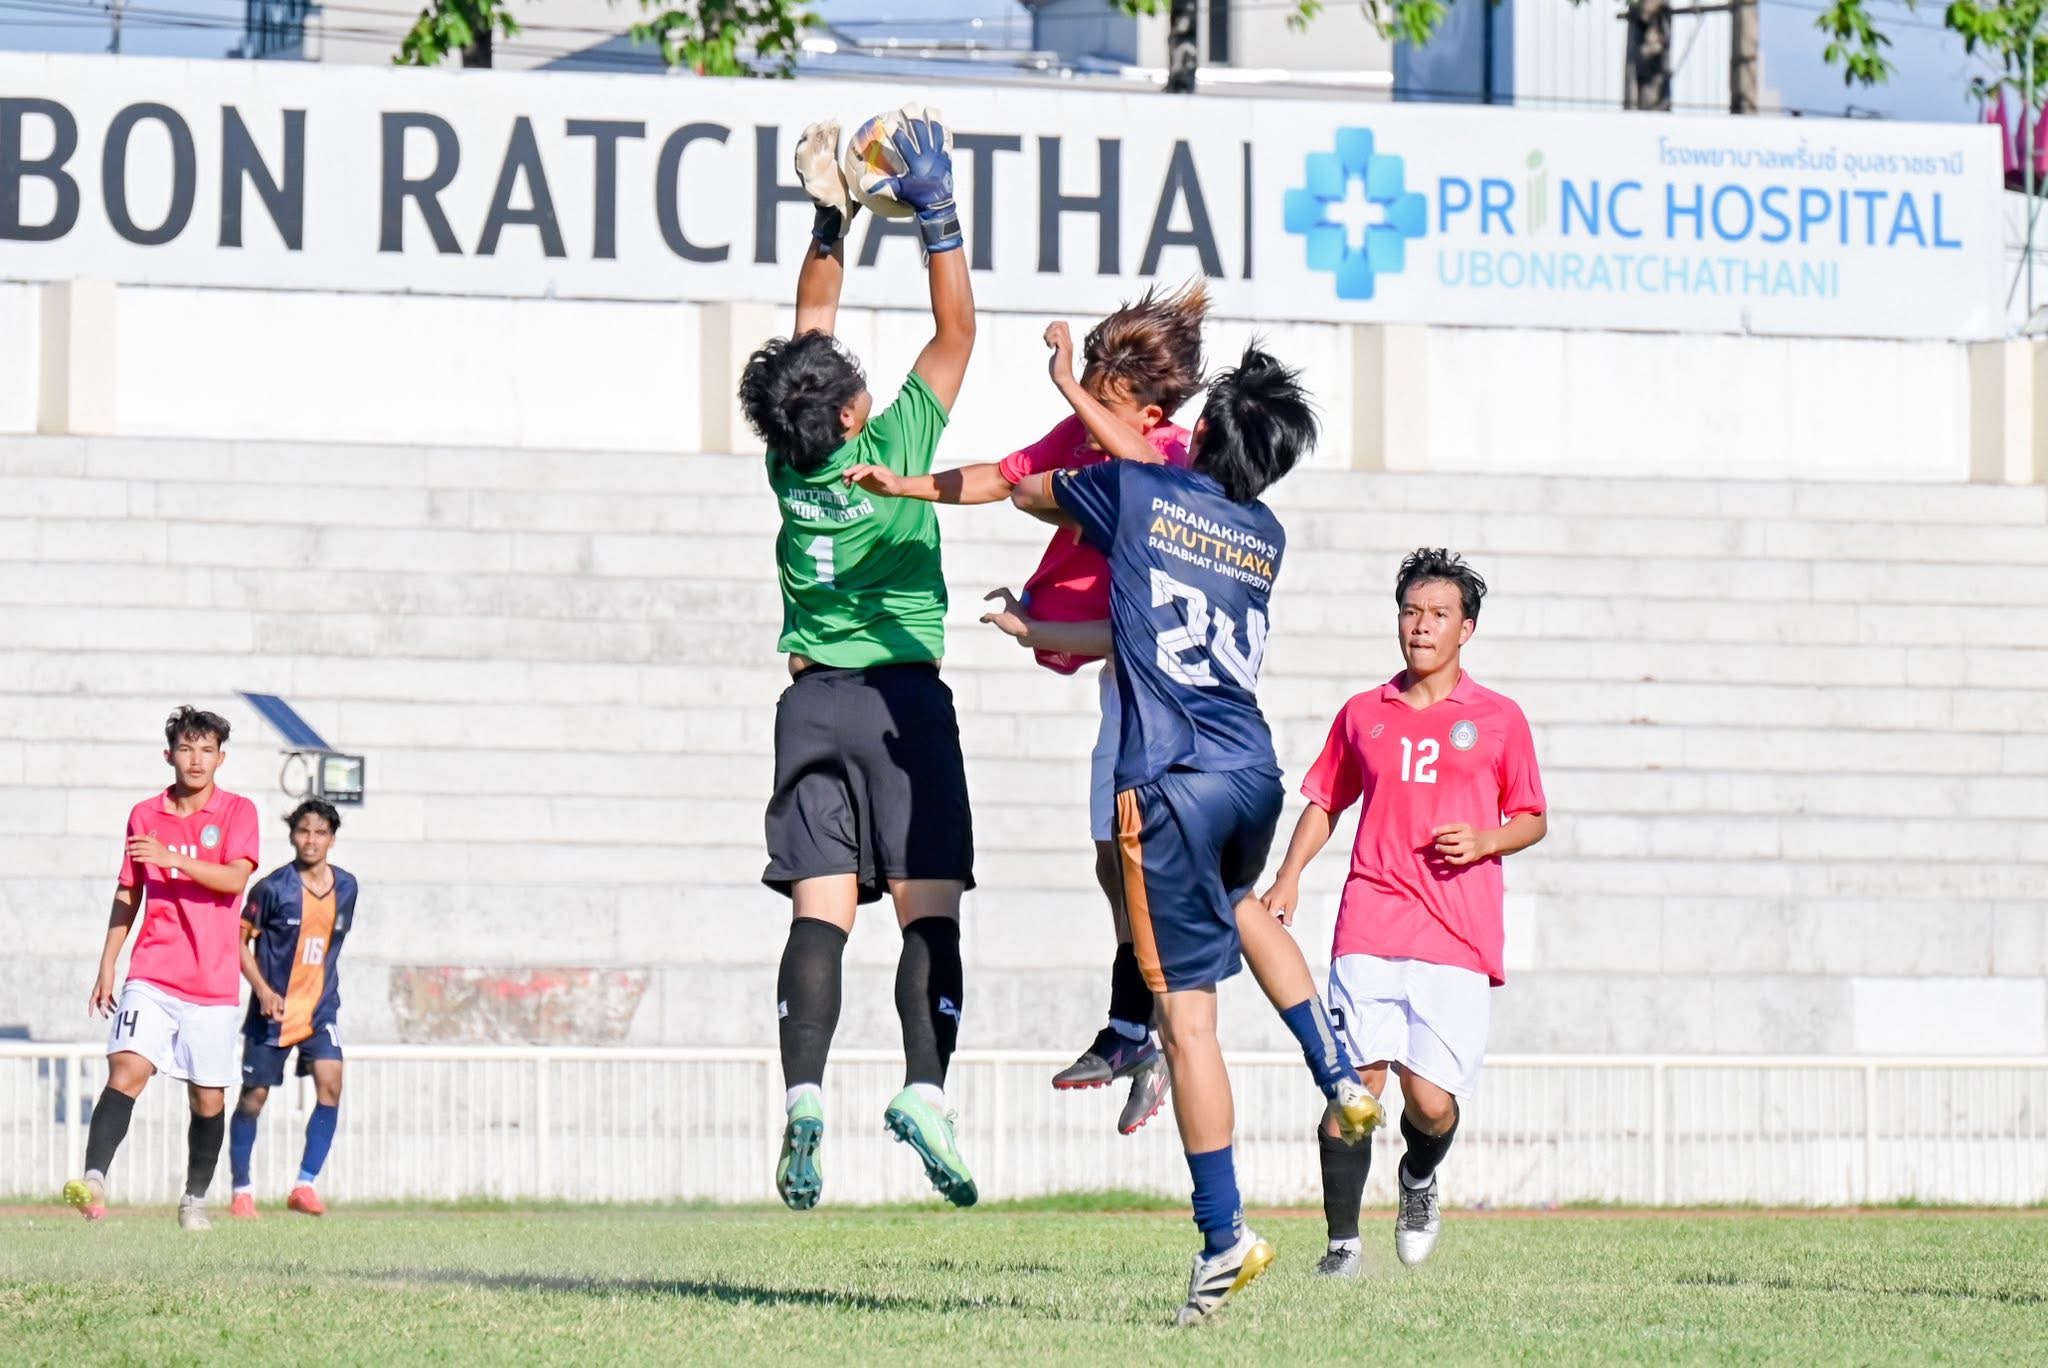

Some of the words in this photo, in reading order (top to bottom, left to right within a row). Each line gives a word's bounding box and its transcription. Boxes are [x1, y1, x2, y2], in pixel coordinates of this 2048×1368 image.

[0, 97, 307, 252] BON
[1666, 182, 1963, 248] HOSPITAL
[1438, 250, 1840, 299] UBONRATCHATHANI
[1150, 516, 1273, 581] AYUTTHAYA
[1151, 497, 1267, 554] PHRANAKHON
[804, 535, 836, 590] 1
[1149, 536, 1212, 569] RAJABHAT
[1214, 562, 1271, 593] UNIVERSITY
[1401, 737, 1440, 784] 12
[302, 936, 325, 965] 16
[115, 1010, 139, 1040] 14
